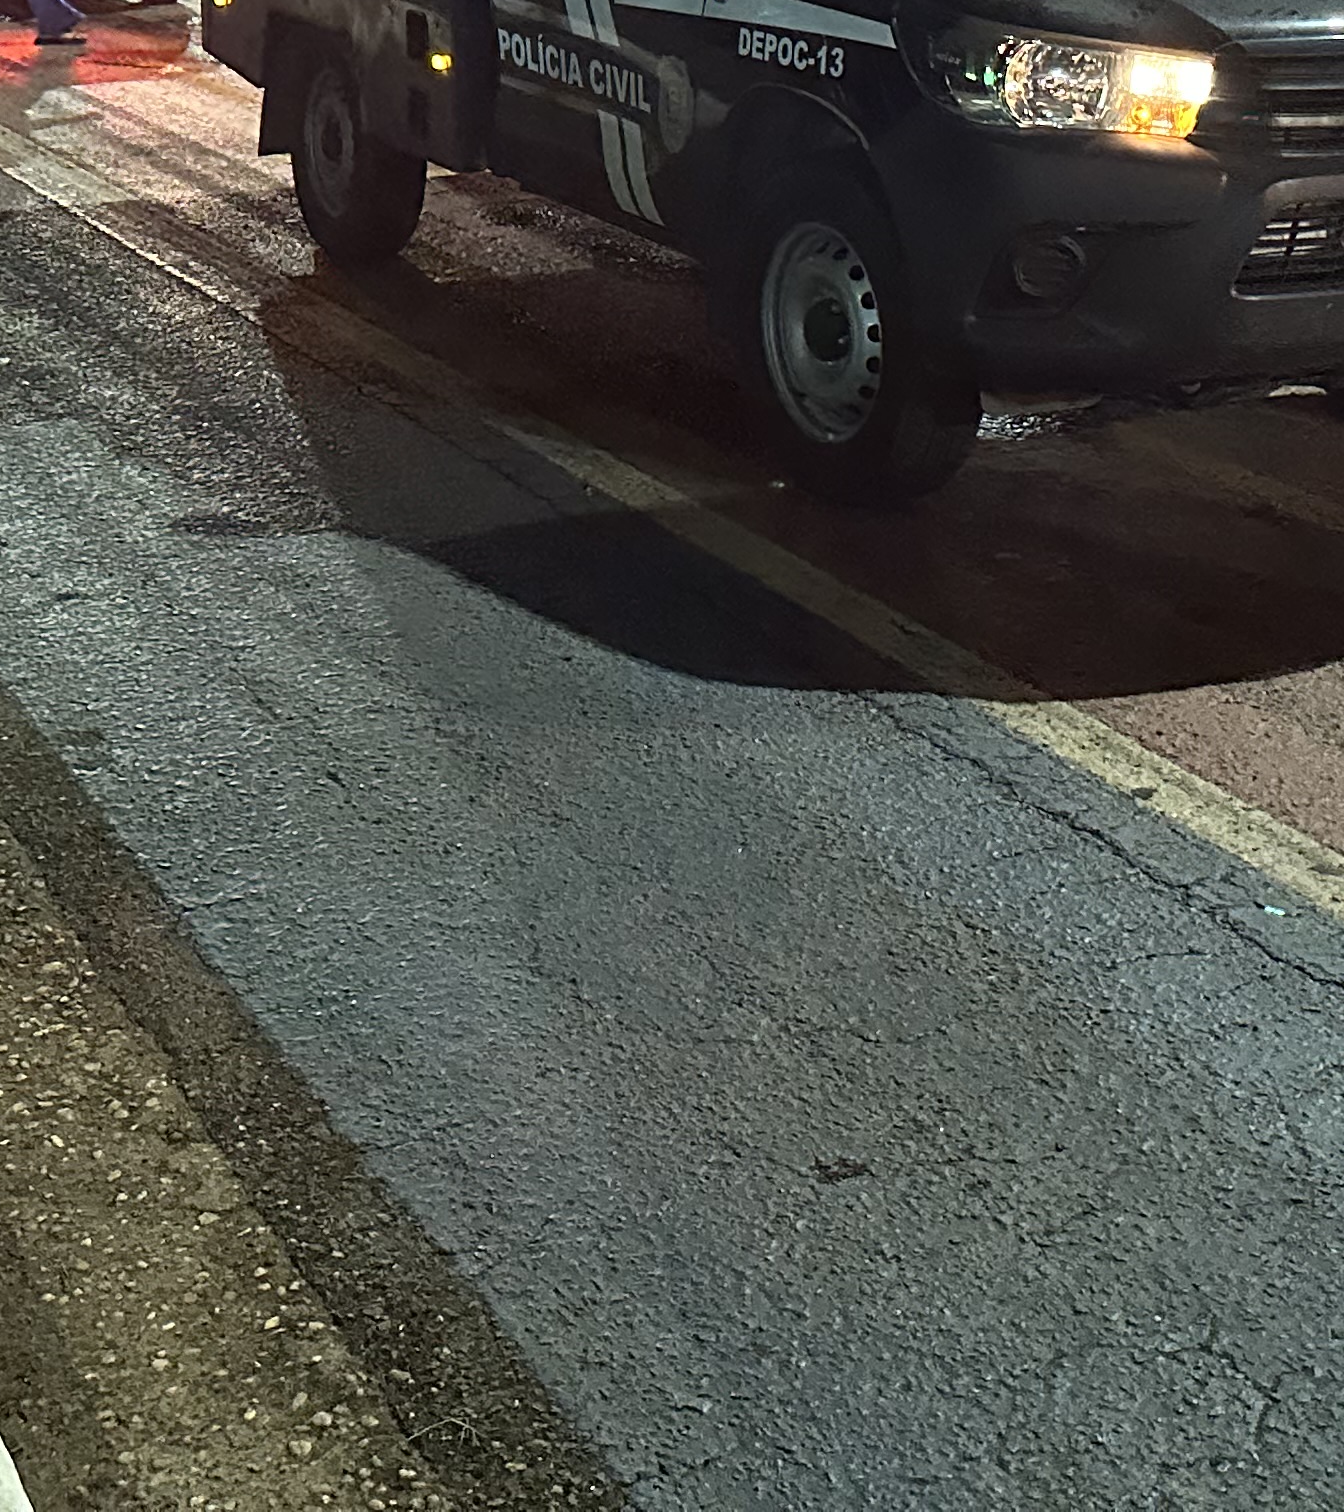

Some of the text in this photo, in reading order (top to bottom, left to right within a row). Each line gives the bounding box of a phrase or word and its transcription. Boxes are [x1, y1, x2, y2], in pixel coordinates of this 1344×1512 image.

[498, 28, 651, 114] POLÍCIA CIVIL
[738, 27, 845, 79] DEPOC-13
